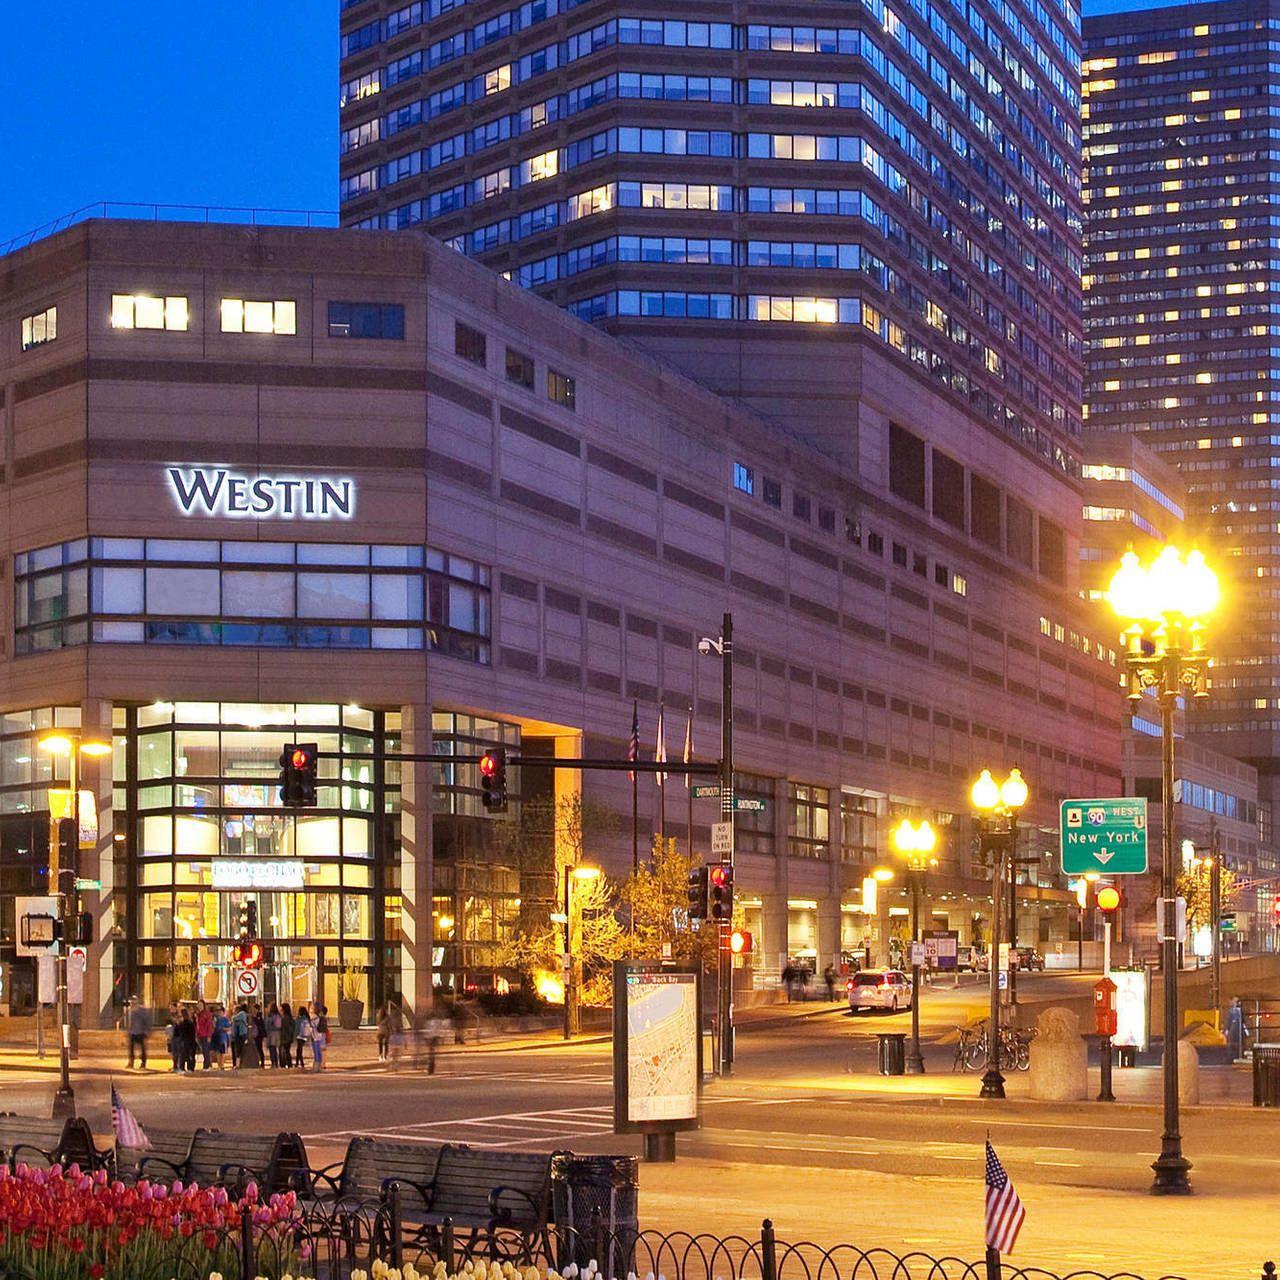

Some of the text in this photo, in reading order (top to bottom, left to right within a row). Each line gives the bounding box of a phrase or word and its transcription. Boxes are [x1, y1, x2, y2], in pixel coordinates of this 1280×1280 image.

[169, 468, 351, 515] WESTIN
[1090, 807, 1140, 823] 90 WEST
[1068, 831, 1140, 844] New York
